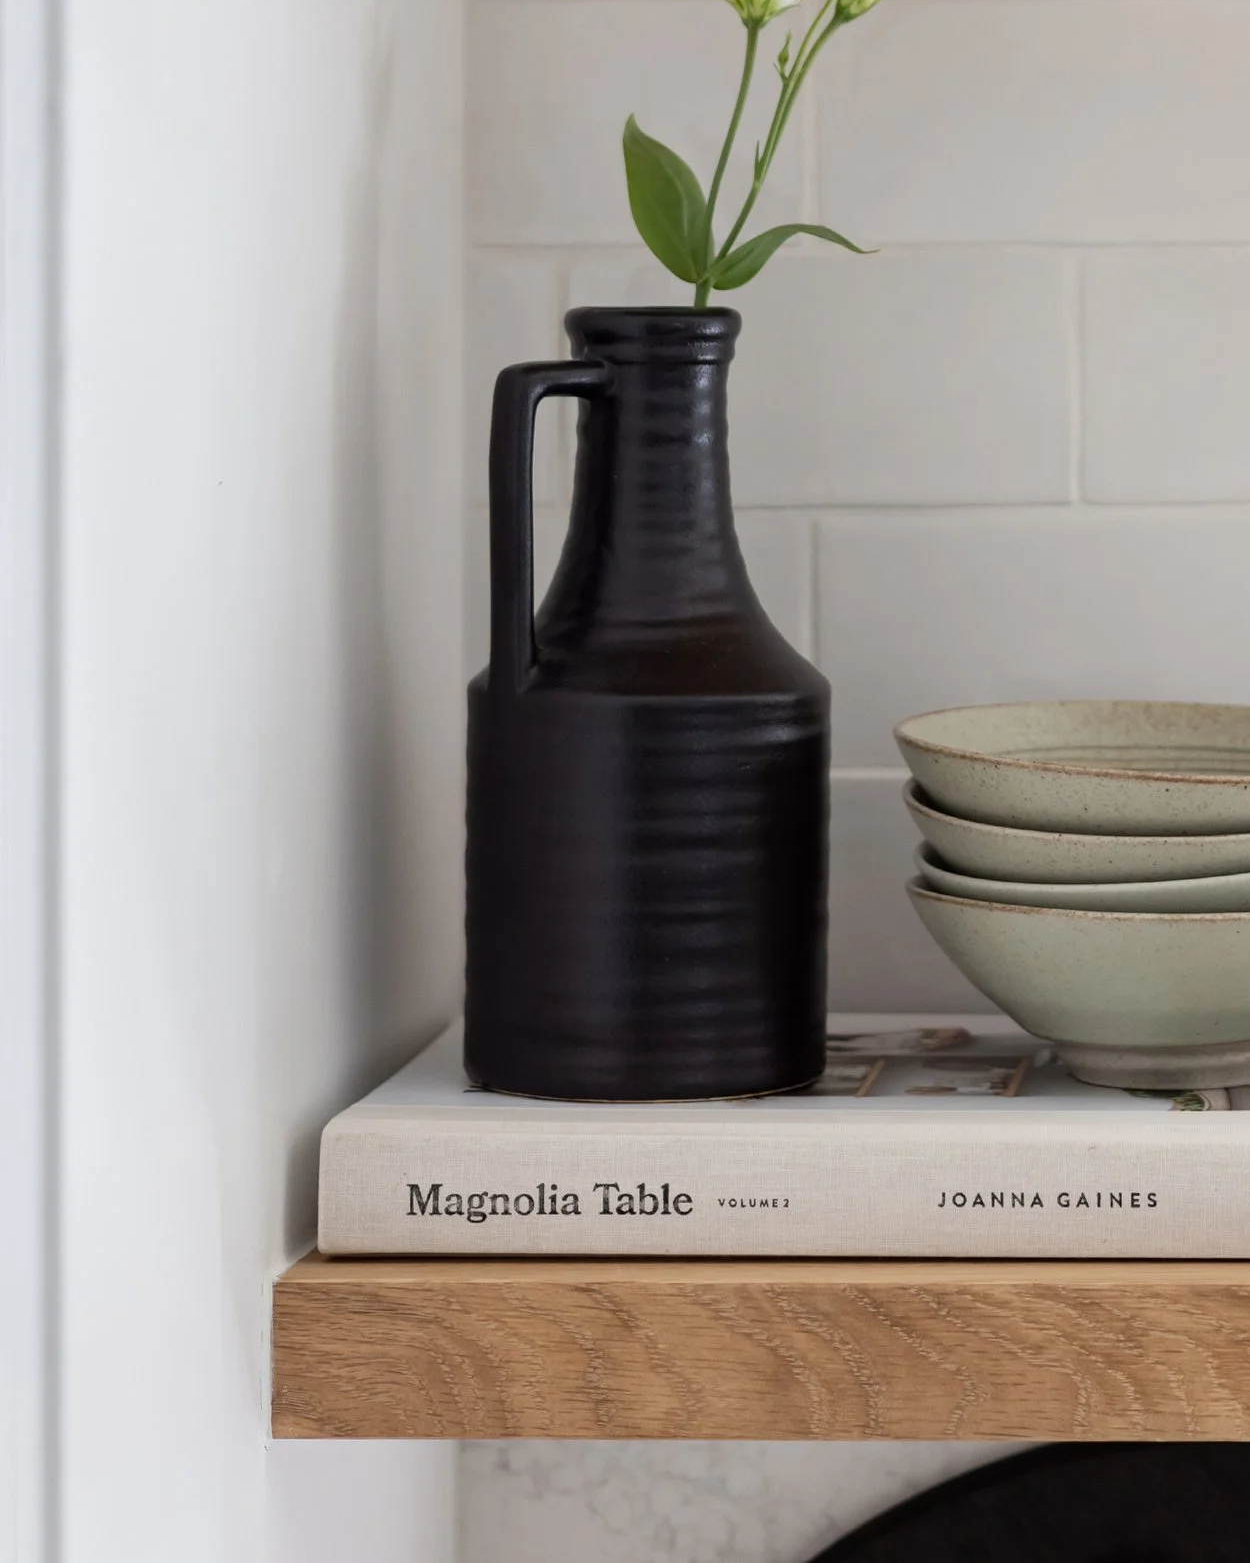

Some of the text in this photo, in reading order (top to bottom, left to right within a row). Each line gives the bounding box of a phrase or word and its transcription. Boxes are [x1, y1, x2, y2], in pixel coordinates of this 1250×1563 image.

[405, 1181, 694, 1224] Magnolia Table
[717, 1197, 779, 1209] VOLUME
[937, 1191, 1158, 1209] JOANNA GAINES
